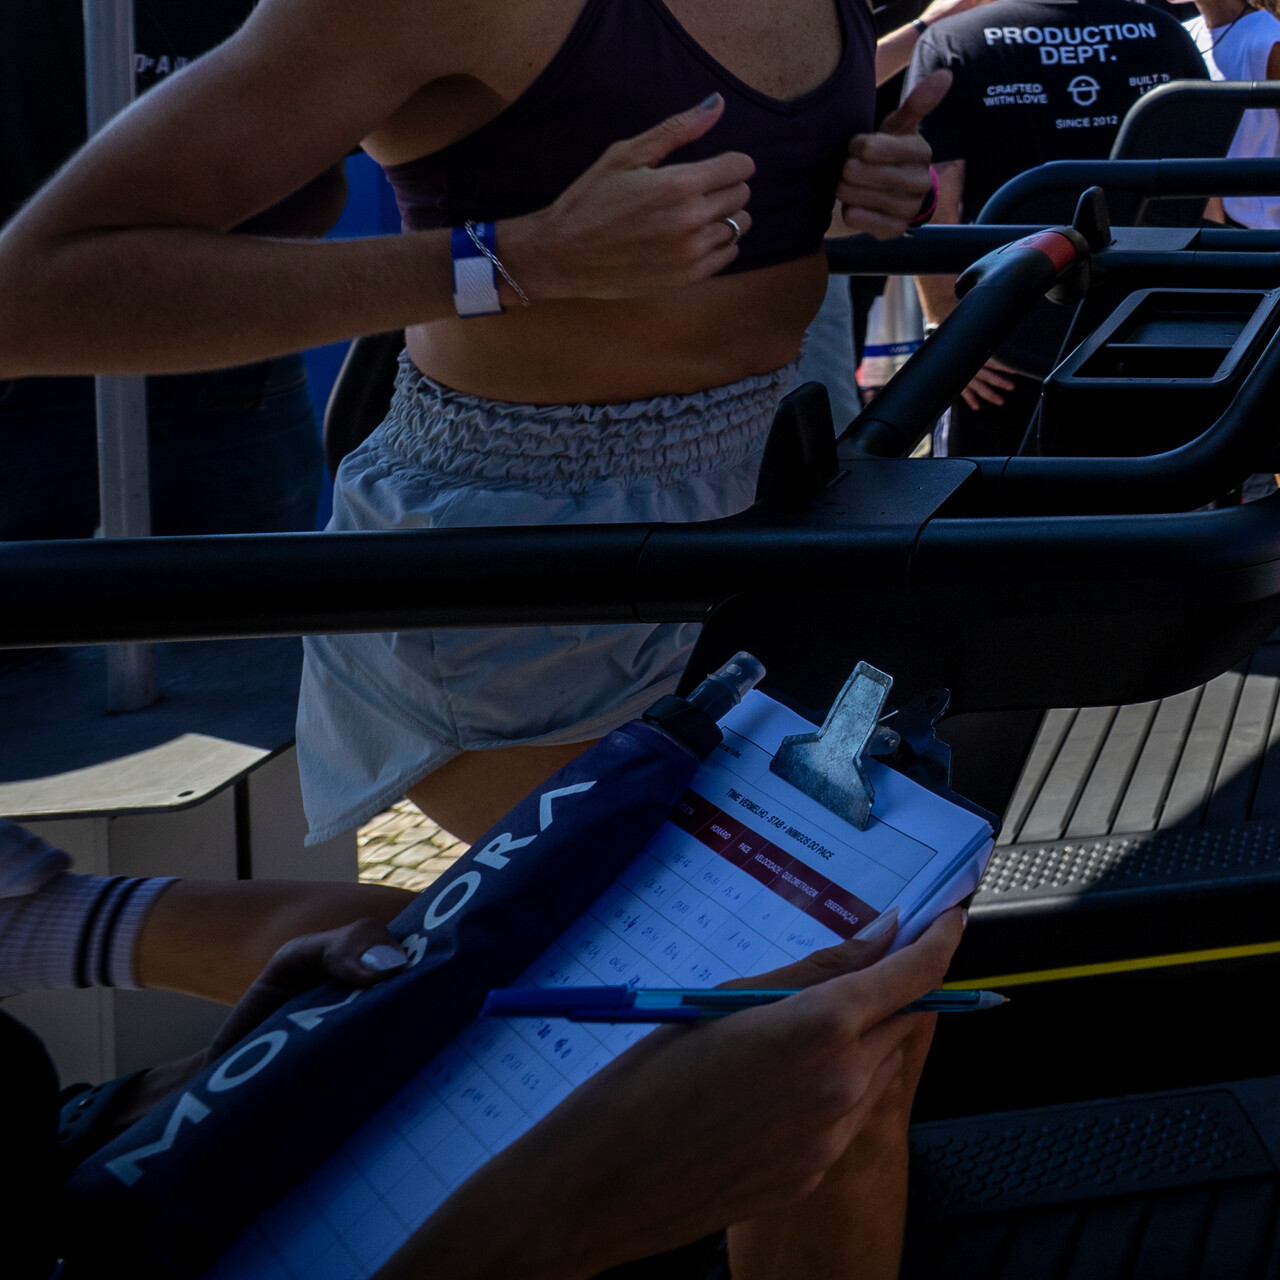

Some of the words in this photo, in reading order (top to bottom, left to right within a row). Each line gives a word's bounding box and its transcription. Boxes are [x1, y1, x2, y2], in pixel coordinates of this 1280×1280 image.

[984, 23, 1157, 45] PRODUCTION
[1039, 44, 1117, 65] DEPT.
[987, 83, 1043, 95] CRAFTED
[983, 95, 1015, 107] WITH
[1016, 93, 1048, 105] LOVE
[1055, 118, 1091, 129] SINCE
[1092, 115, 1119, 126] 2012
[726, 788, 742, 802] TIME
[739, 797, 769, 818] VERMELHO
[768, 816, 783, 829] STAB
[785, 826, 809, 846] INIMIGOS
[808, 840, 819, 851] DO
[817, 846, 834, 860] PACE
[737, 842, 752, 854] PACE
[754, 853, 783, 875] VELOCIDADE
